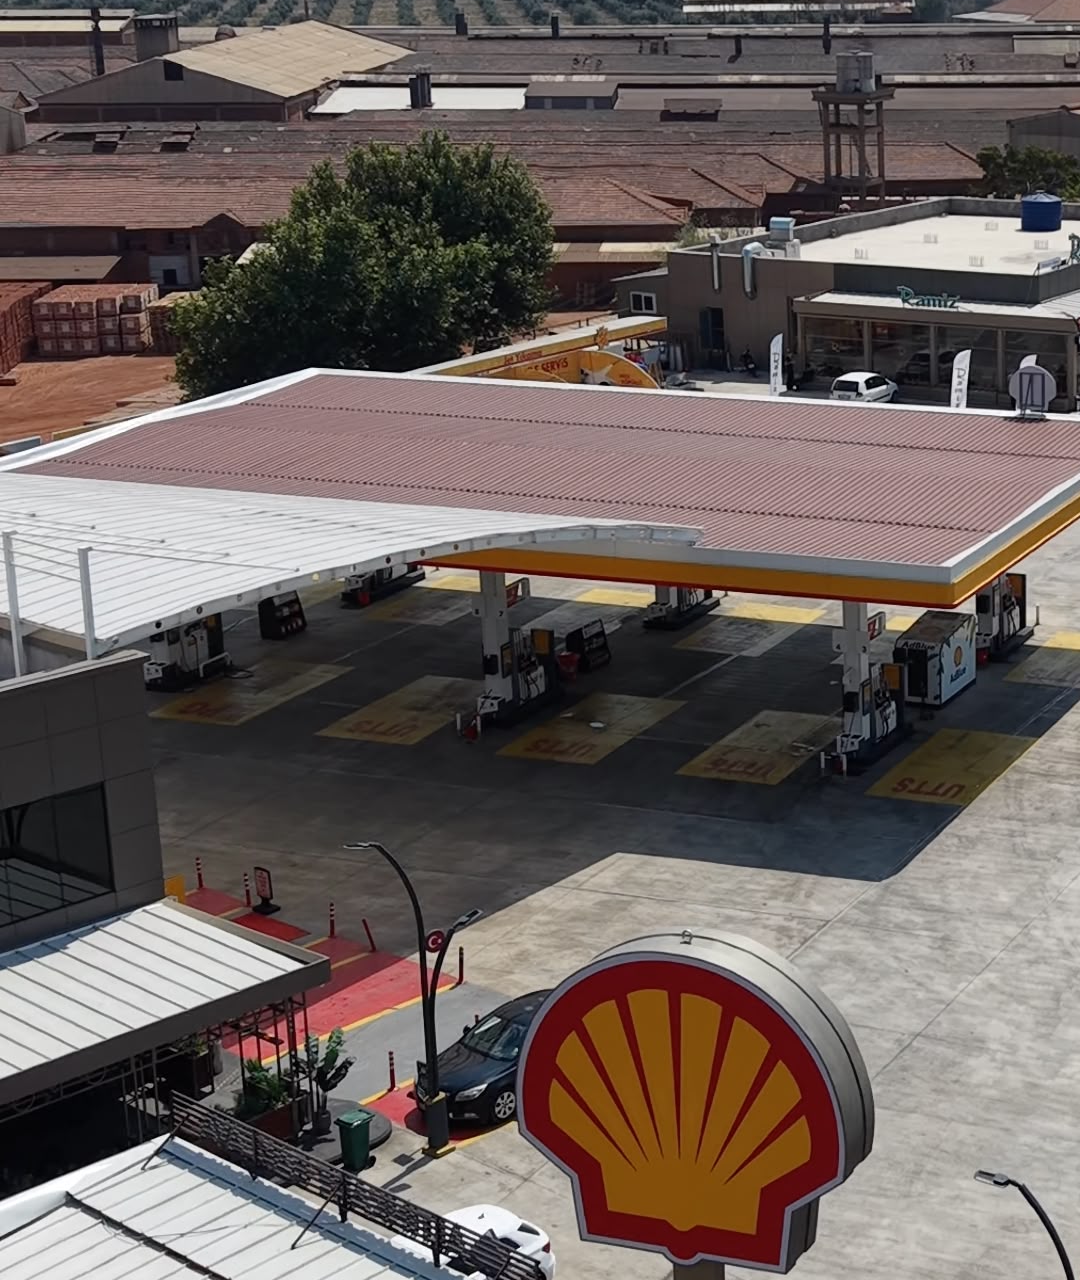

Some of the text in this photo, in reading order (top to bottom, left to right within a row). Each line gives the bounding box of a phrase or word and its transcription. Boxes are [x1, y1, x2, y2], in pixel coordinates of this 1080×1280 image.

[897, 286, 960, 309] Ramiz
[902, 641, 936, 651] AdBlue
[892, 777, 965, 799] UTTS
